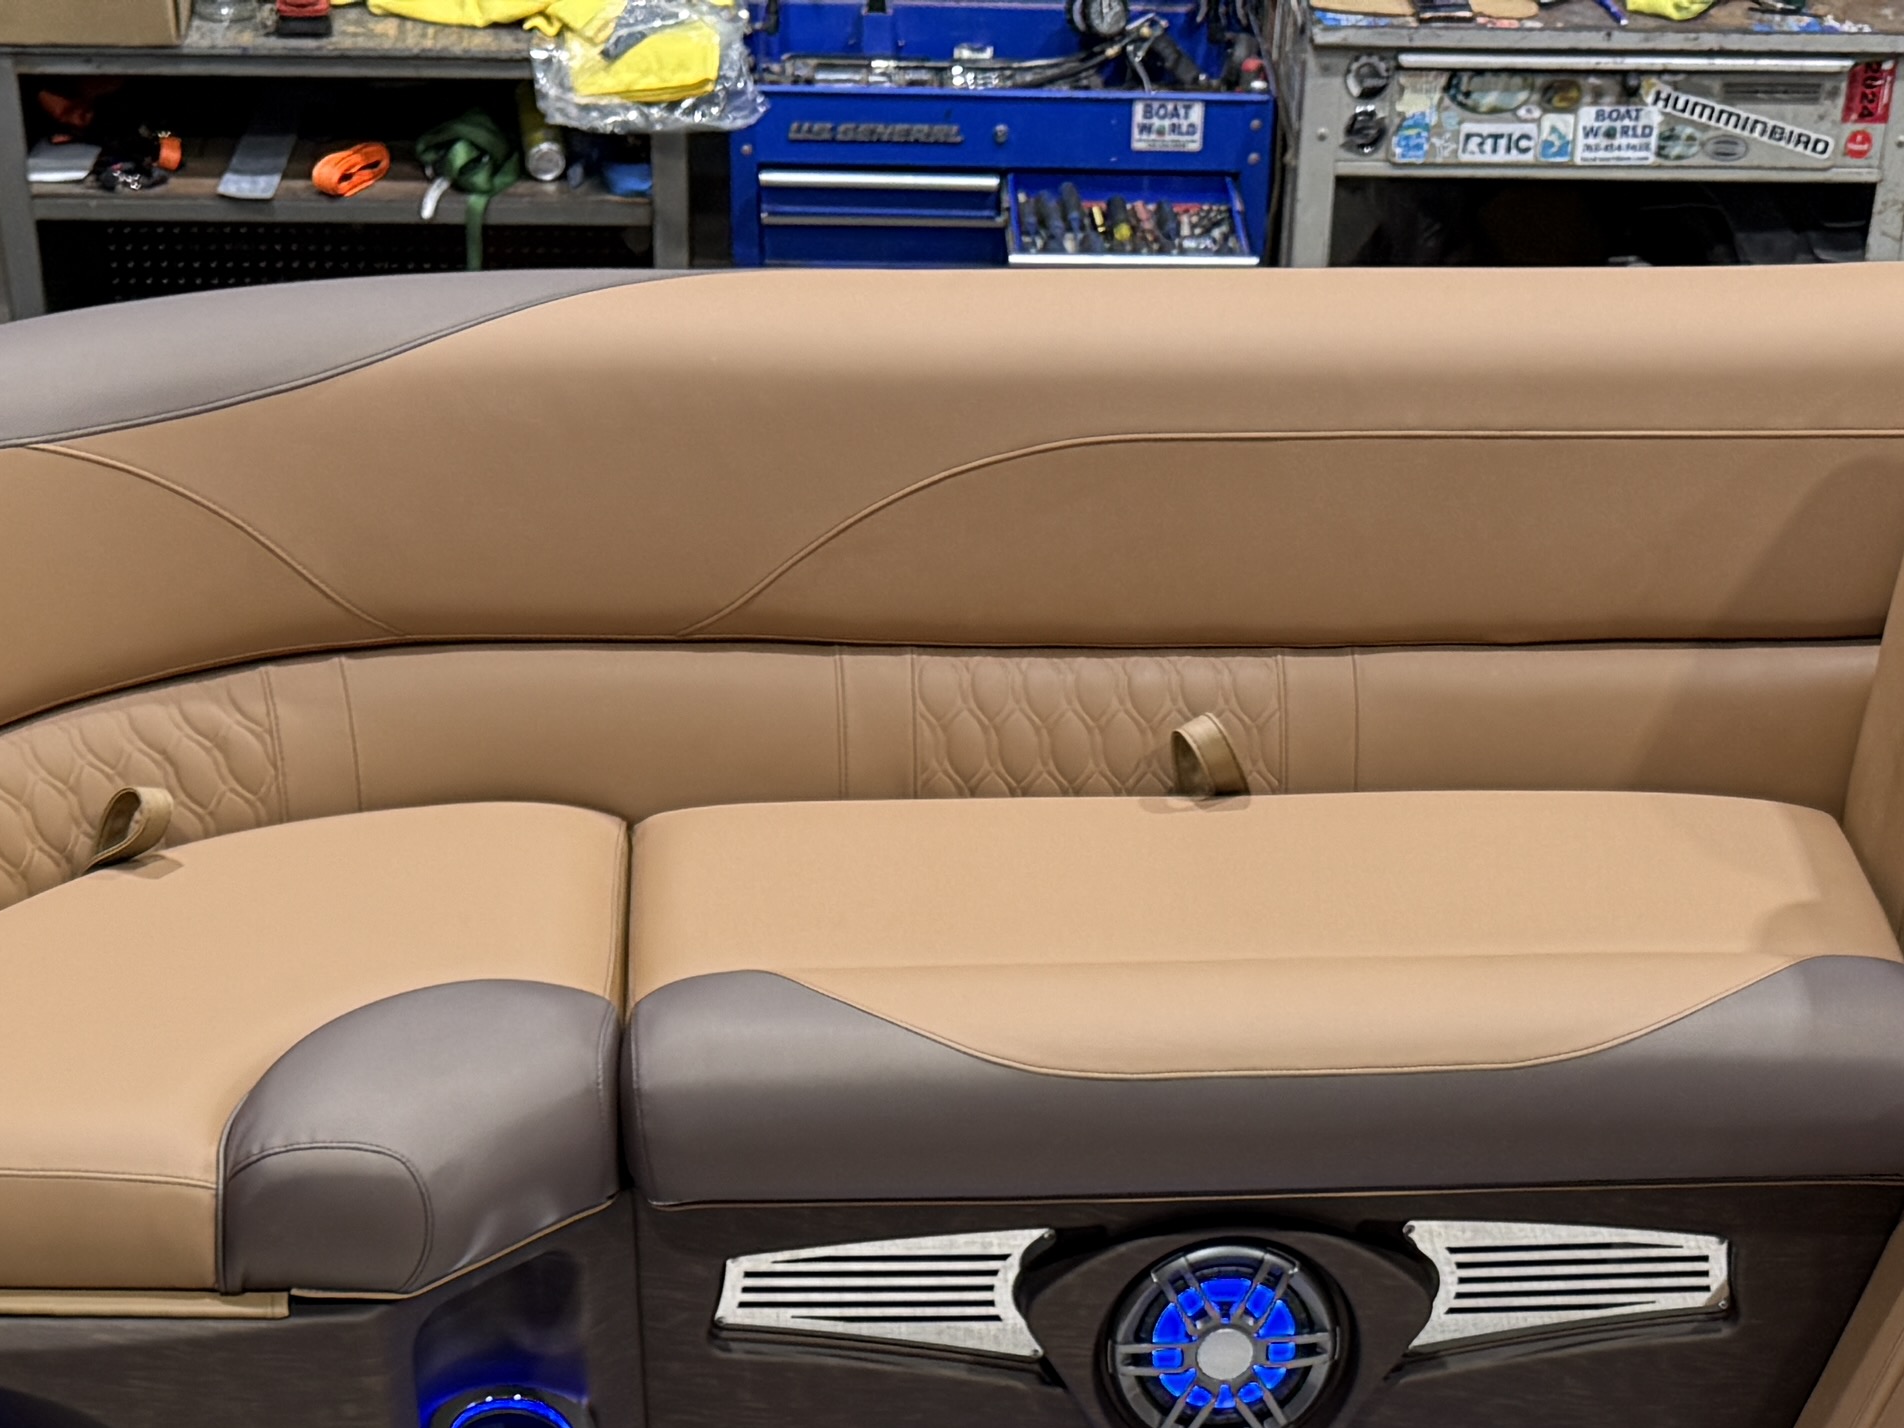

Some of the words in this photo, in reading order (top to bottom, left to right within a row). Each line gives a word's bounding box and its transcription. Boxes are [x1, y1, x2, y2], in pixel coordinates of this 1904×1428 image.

[1142, 103, 1193, 120] BOAT
[1594, 108, 1644, 122] BOAT
[835, 123, 965, 143] GENERAL
[1652, 90, 1830, 156] HUMMINBIRD
[1461, 132, 1533, 155] RTIC
